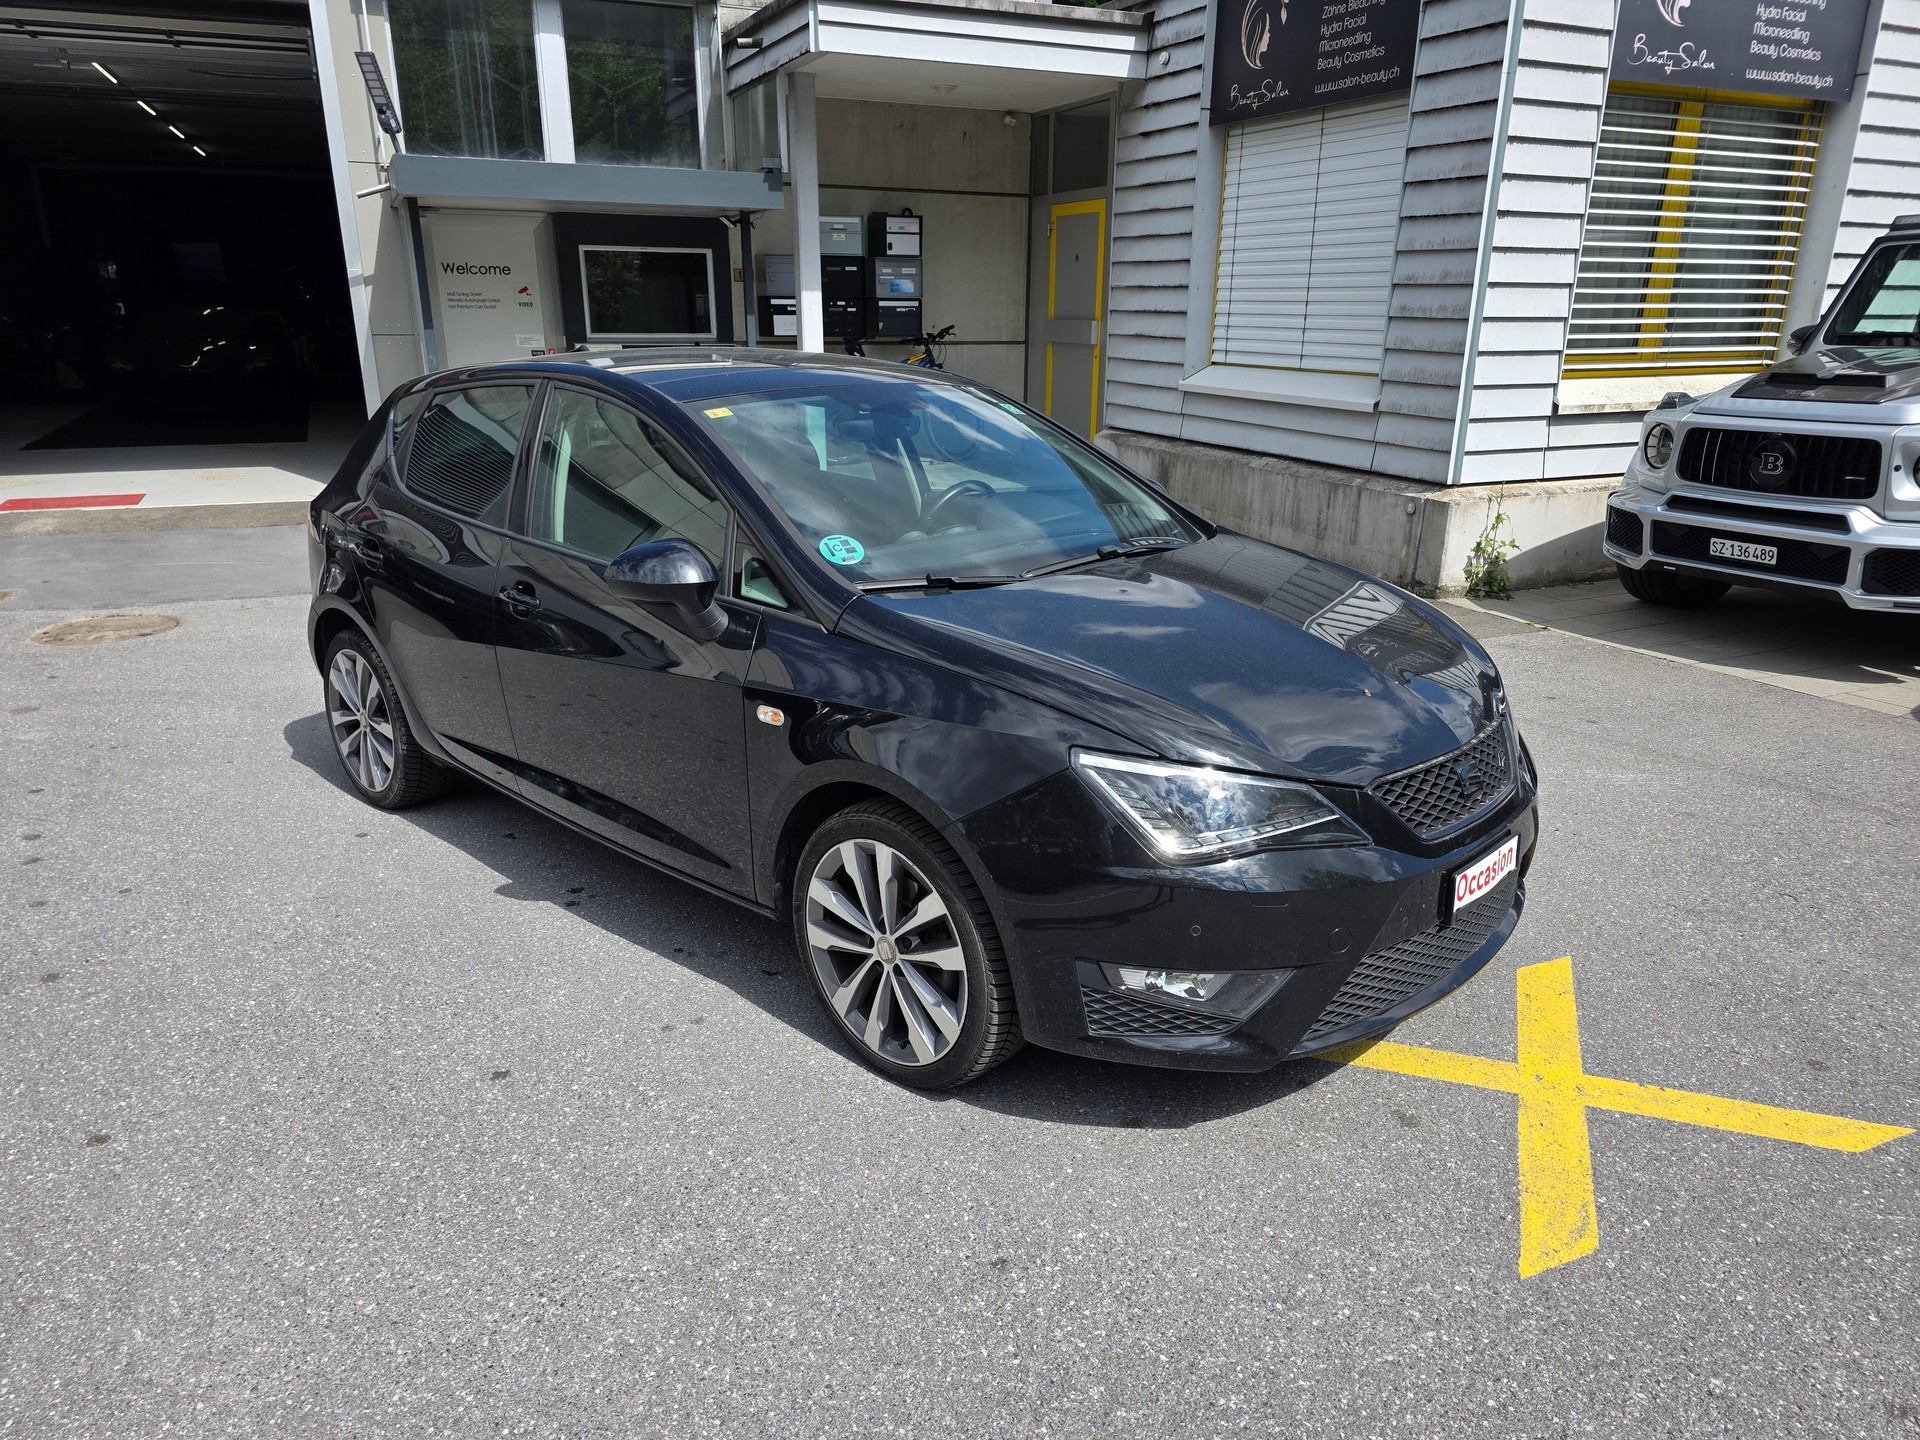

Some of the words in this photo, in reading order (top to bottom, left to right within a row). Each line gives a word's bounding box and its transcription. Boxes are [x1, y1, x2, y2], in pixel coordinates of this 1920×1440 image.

[1321, 21, 1342, 37] Hydra
[1344, 12, 1367, 30] Facial
[1756, 3, 1781, 20] Hydra
[1782, 7, 1807, 22] Facial
[1319, 31, 1372, 53] Microneedling
[1753, 21, 1811, 44] Microneedling
[1317, 55, 1342, 70] Beauty
[1344, 45, 1385, 64] Cosmetics
[1627, 33, 1682, 75] Beauty
[1679, 42, 1716, 69] Salon
[1750, 40, 1779, 59] Beauty
[1780, 43, 1822, 61] Cosmetics
[1314, 65, 1400, 94] www.salon-beauty.ch
[1745, 68, 1834, 89] www.salon-beauty.ch
[1226, 84, 1263, 110] Beauty
[1262, 79, 1290, 102] Salon
[440, 262, 511, 276] Welcome
[1456, 846, 1514, 902] Occasion
